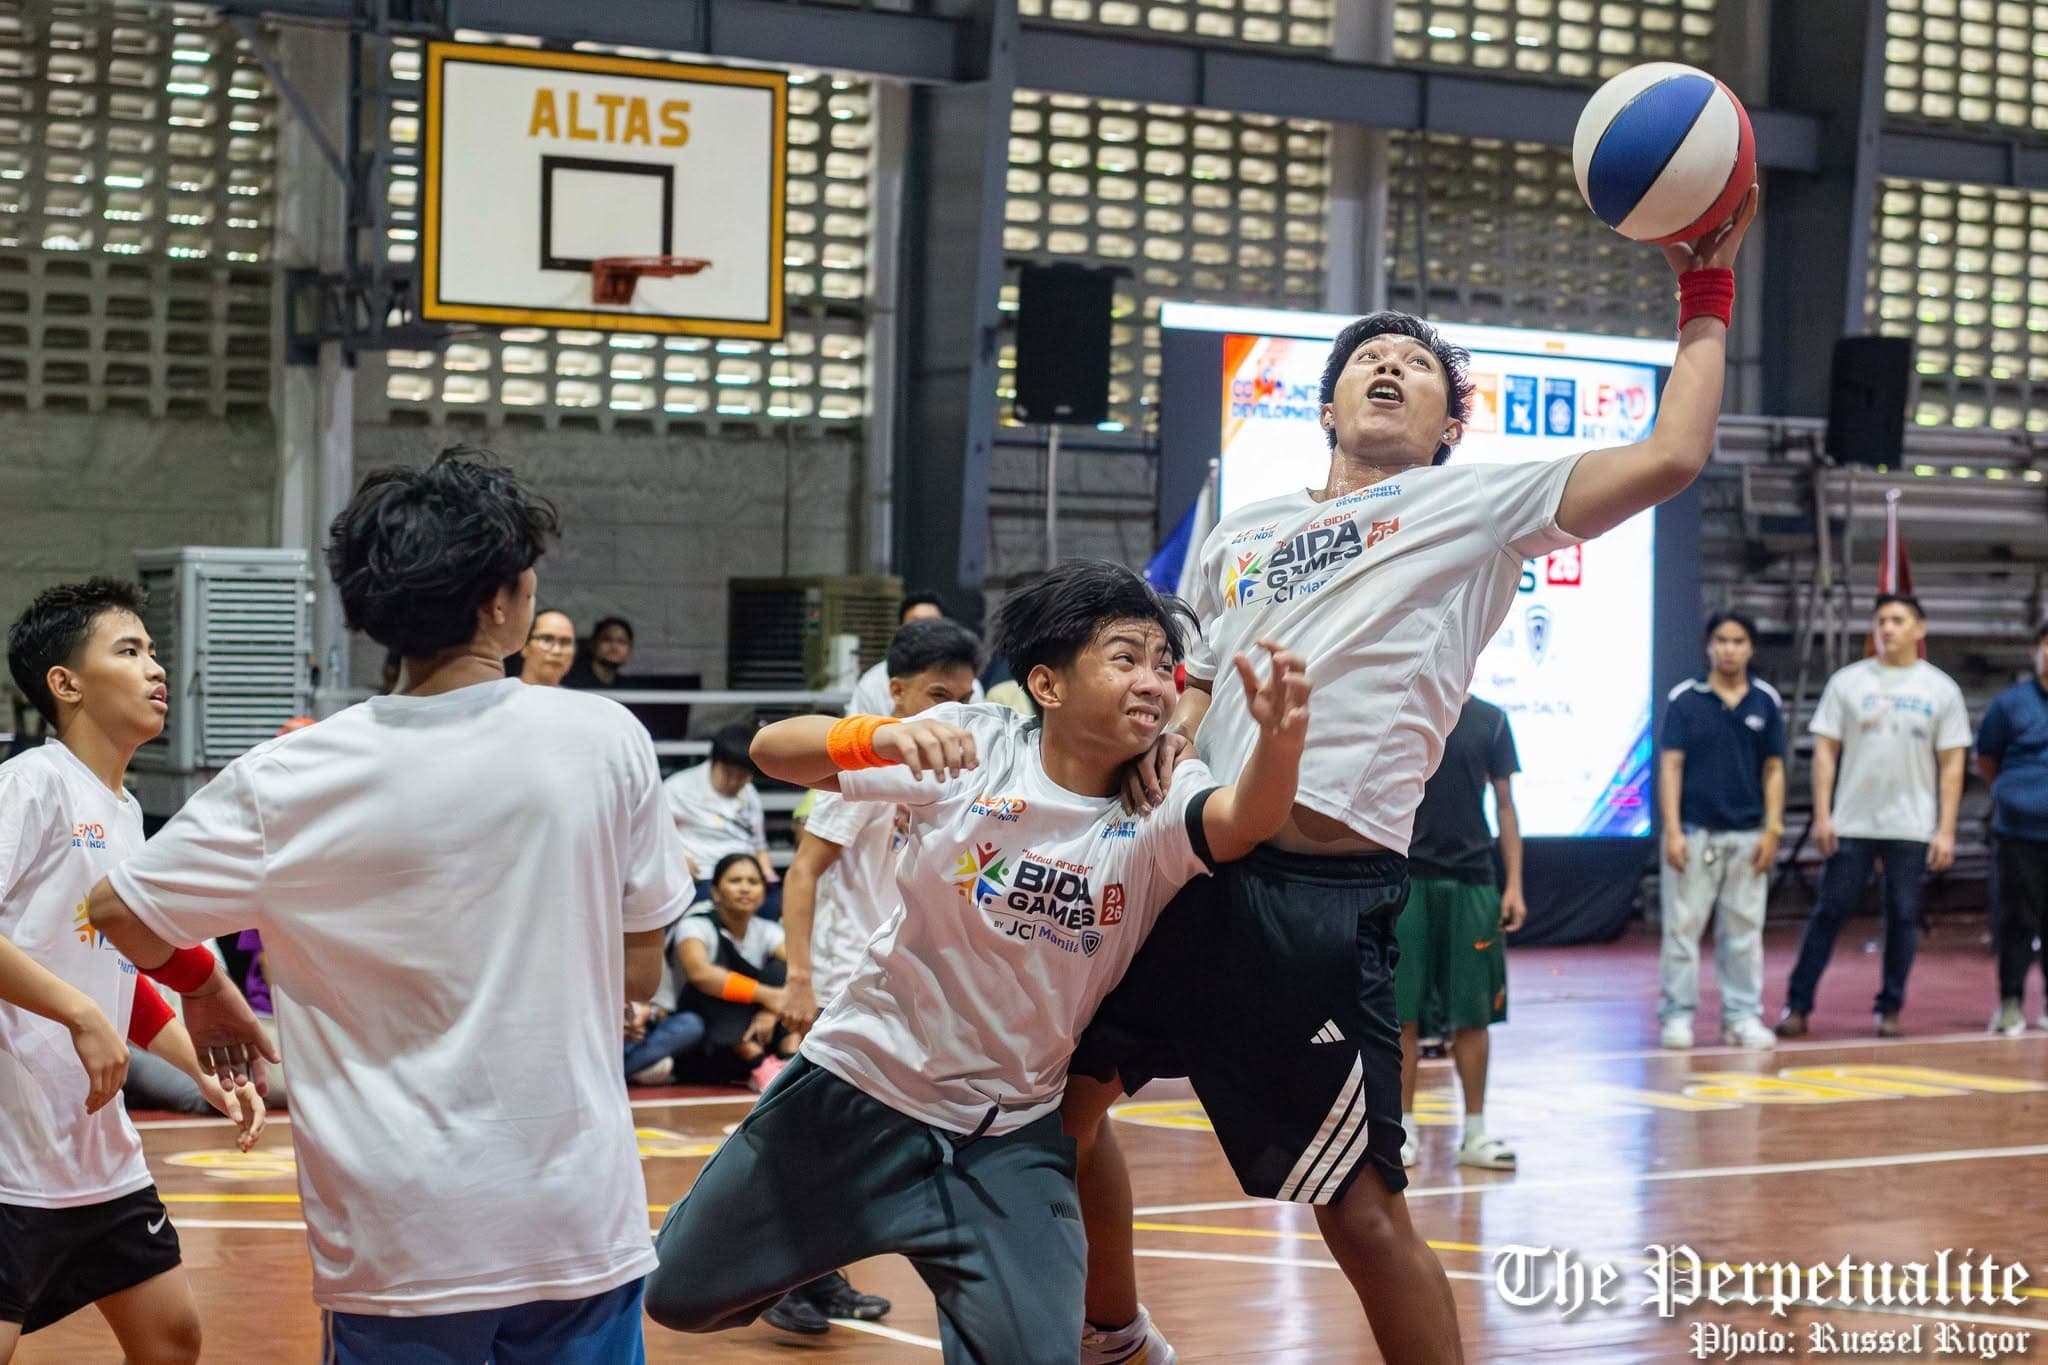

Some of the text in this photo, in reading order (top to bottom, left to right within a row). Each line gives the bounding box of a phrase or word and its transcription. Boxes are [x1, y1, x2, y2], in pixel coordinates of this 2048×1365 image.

[528, 88, 692, 148] ALTAS
[1268, 519, 1362, 568] BIDA
[1267, 545, 1363, 589] GAMES
[1013, 860, 1094, 906] BIDA
[994, 920, 1004, 929] BY
[1006, 920, 1036, 941] JCI
[1007, 891, 1095, 930] GAMES
[1103, 905, 1123, 922] 26
